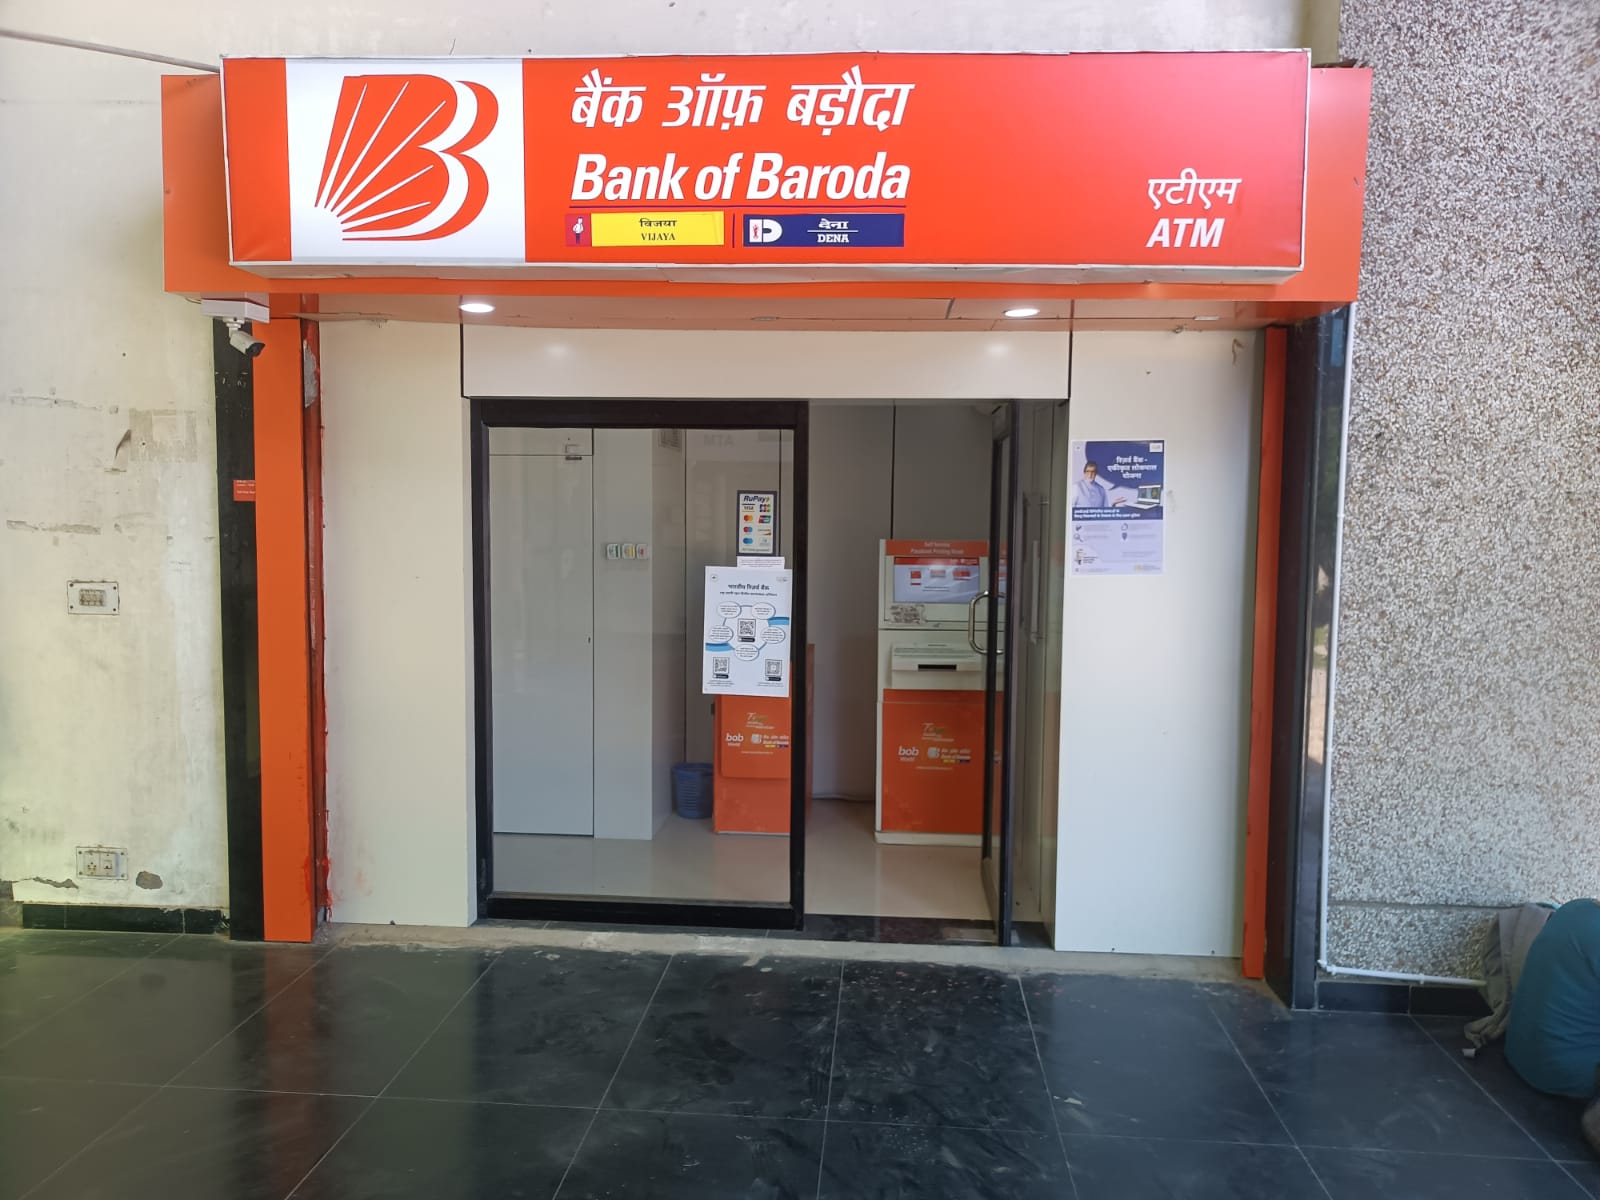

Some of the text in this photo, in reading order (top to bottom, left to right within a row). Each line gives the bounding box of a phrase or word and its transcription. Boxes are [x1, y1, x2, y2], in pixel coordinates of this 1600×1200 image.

[571, 65, 915, 136] बैंक ऑफ़ बड़ौदा
[570, 152, 911, 201] Bank of Baroda
[1147, 167, 1242, 210] एटीएम
[639, 218, 678, 228] विजया
[641, 232, 676, 241] VIJAYA
[817, 233, 850, 243] DENA
[1145, 218, 1226, 248] ATM
[743, 495, 766, 503] RuPay
[726, 732, 744, 742] bob
[898, 745, 919, 756] bob
